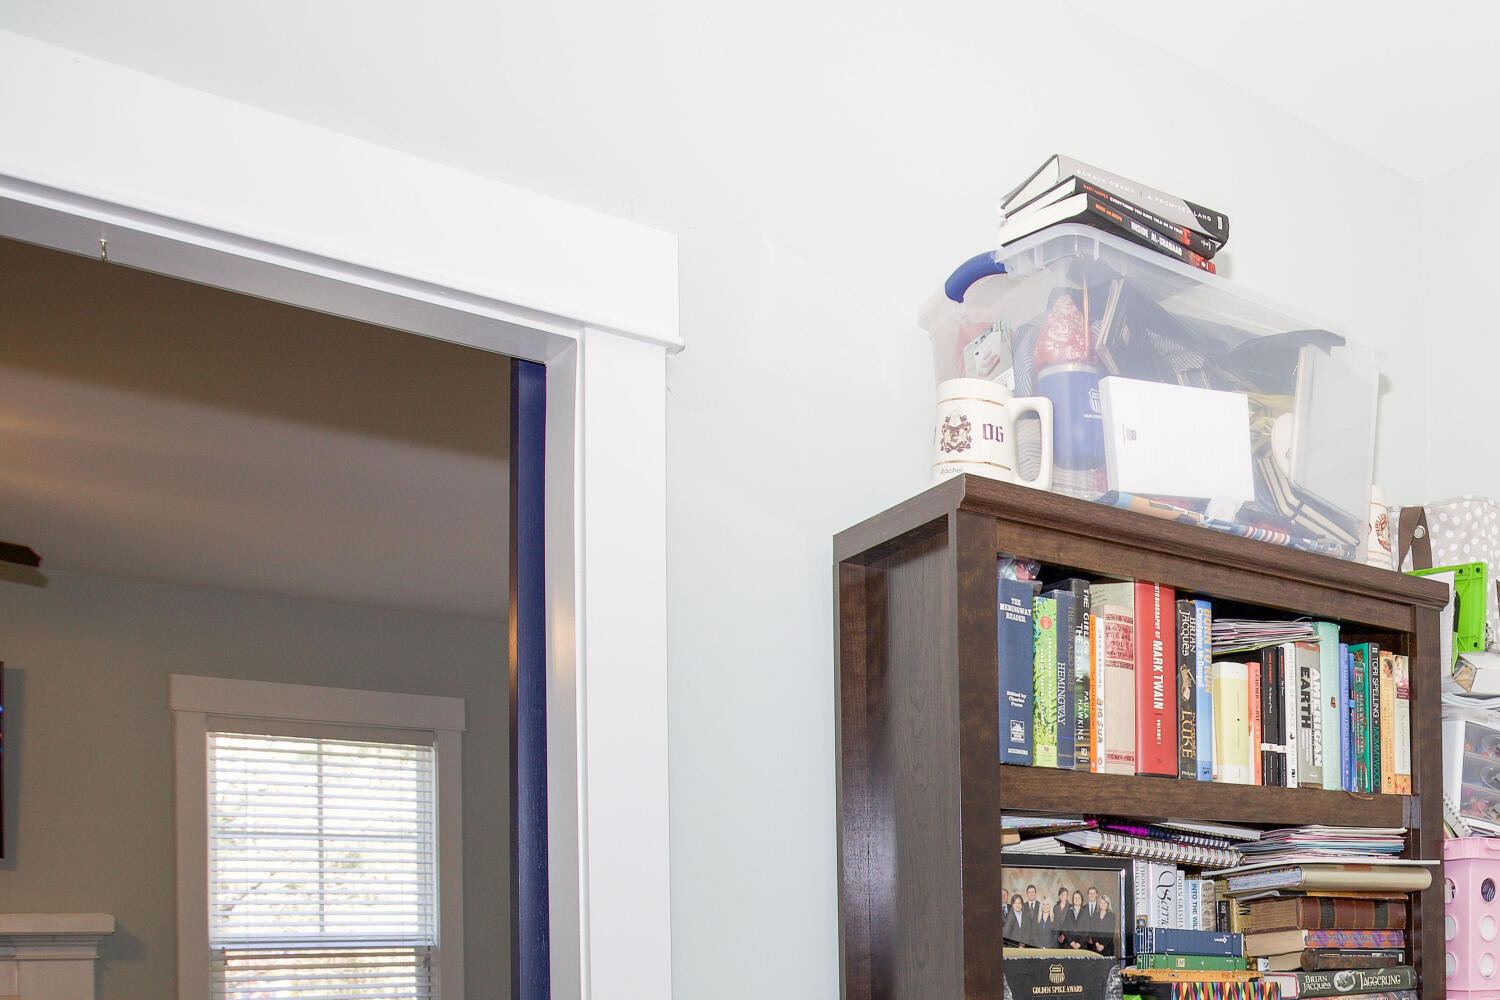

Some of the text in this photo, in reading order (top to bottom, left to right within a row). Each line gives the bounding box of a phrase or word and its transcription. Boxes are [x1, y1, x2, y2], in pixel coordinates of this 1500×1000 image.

[1108, 180, 1135, 194] OBAMA
[1194, 211, 1212, 222] LAND
[1000, 603, 1031, 616] HEMINGWAY
[1006, 612, 1026, 623] READER
[1011, 598, 1021, 606] THE
[1189, 617, 1197, 652] BRIAN
[1204, 608, 1212, 646] BORN
[1152, 640, 1163, 672] MARK
[1153, 675, 1164, 710] TWAIN
[1300, 666, 1311, 728] EARTH
[1181, 708, 1194, 758] LUKE
[1313, 668, 1322, 767] AMERICAN
[1032, 986, 1050, 994] GOLDEN
[1066, 985, 1083, 993] AWARD
[1305, 975, 1328, 983] BRIAN
